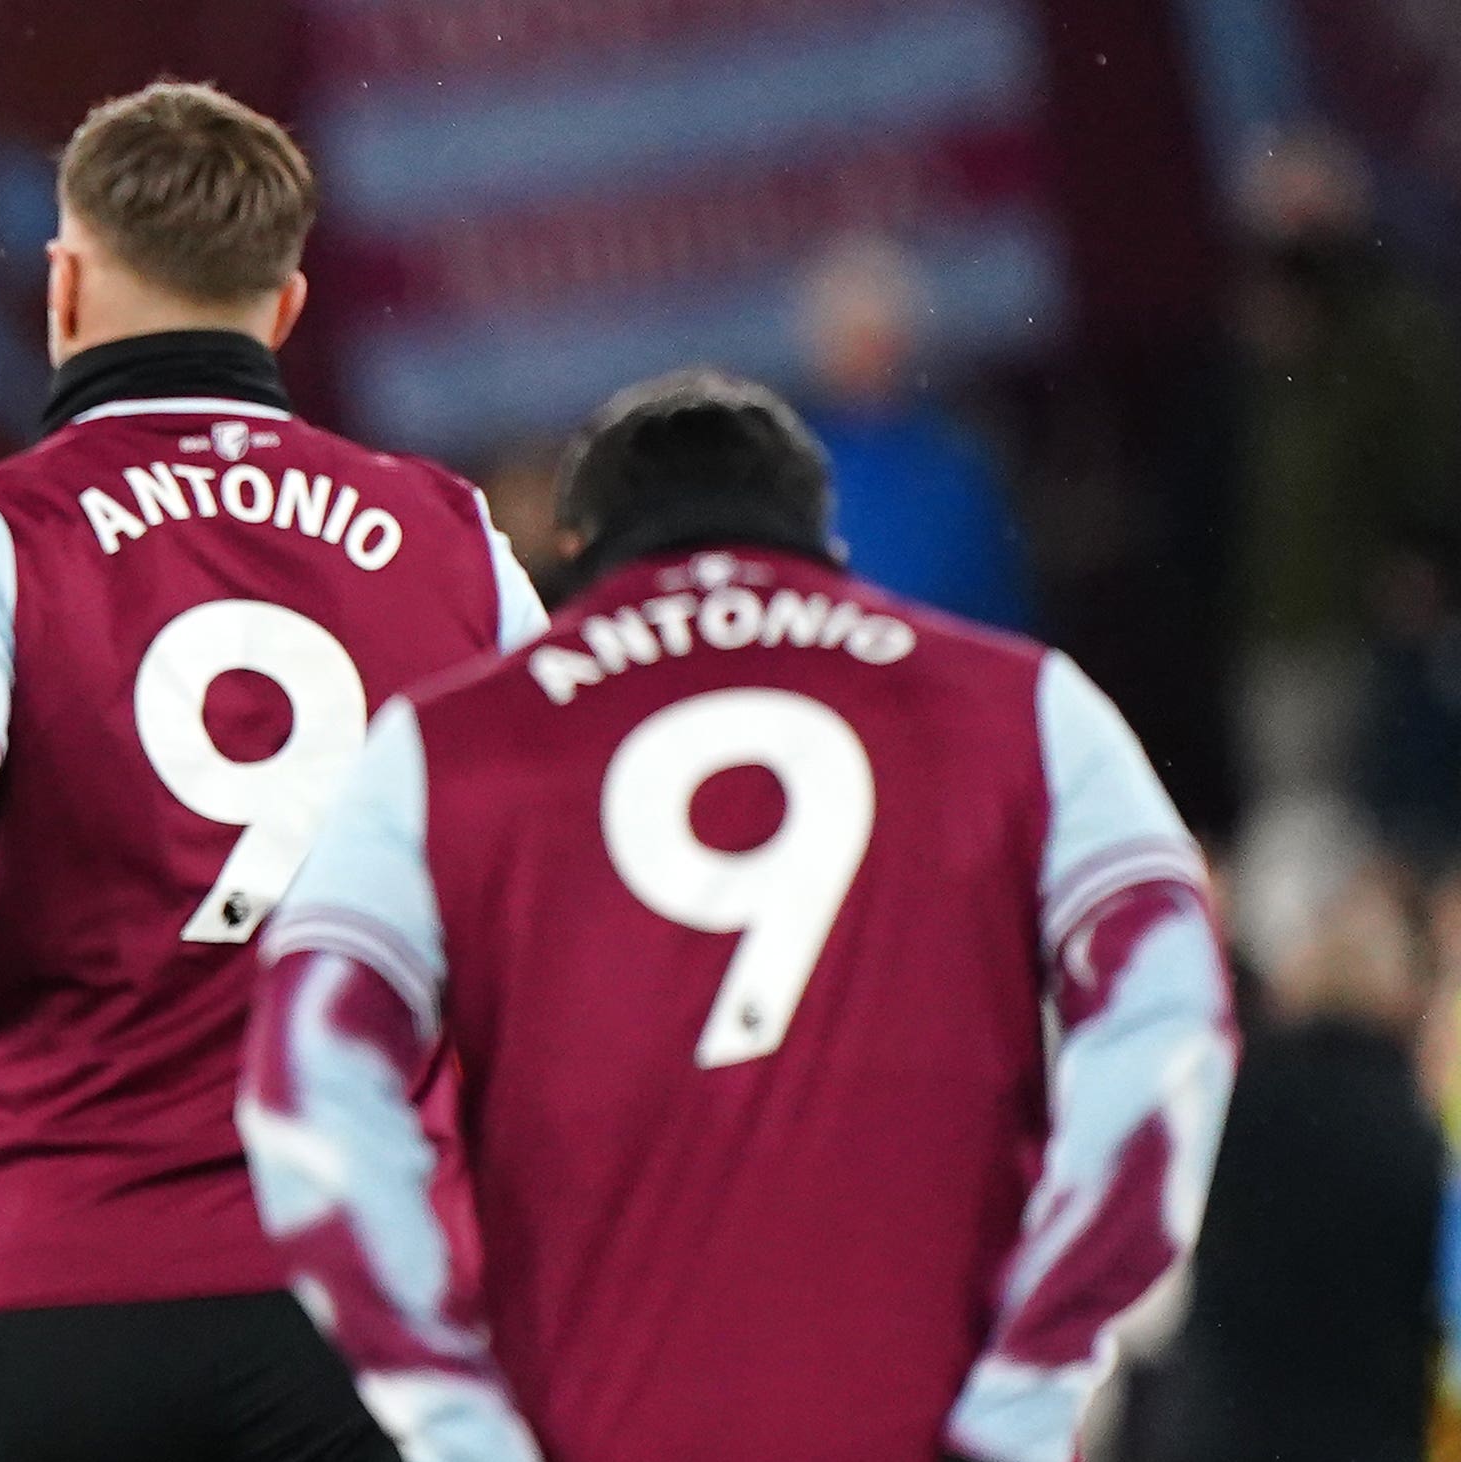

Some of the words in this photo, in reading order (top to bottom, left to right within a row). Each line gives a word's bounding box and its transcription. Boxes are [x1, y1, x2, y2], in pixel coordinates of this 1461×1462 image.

[79, 461, 403, 571] ANTONIO
[526, 585, 916, 705] ANTONIO
[133, 598, 367, 944] 9
[600, 687, 875, 1069] 9
